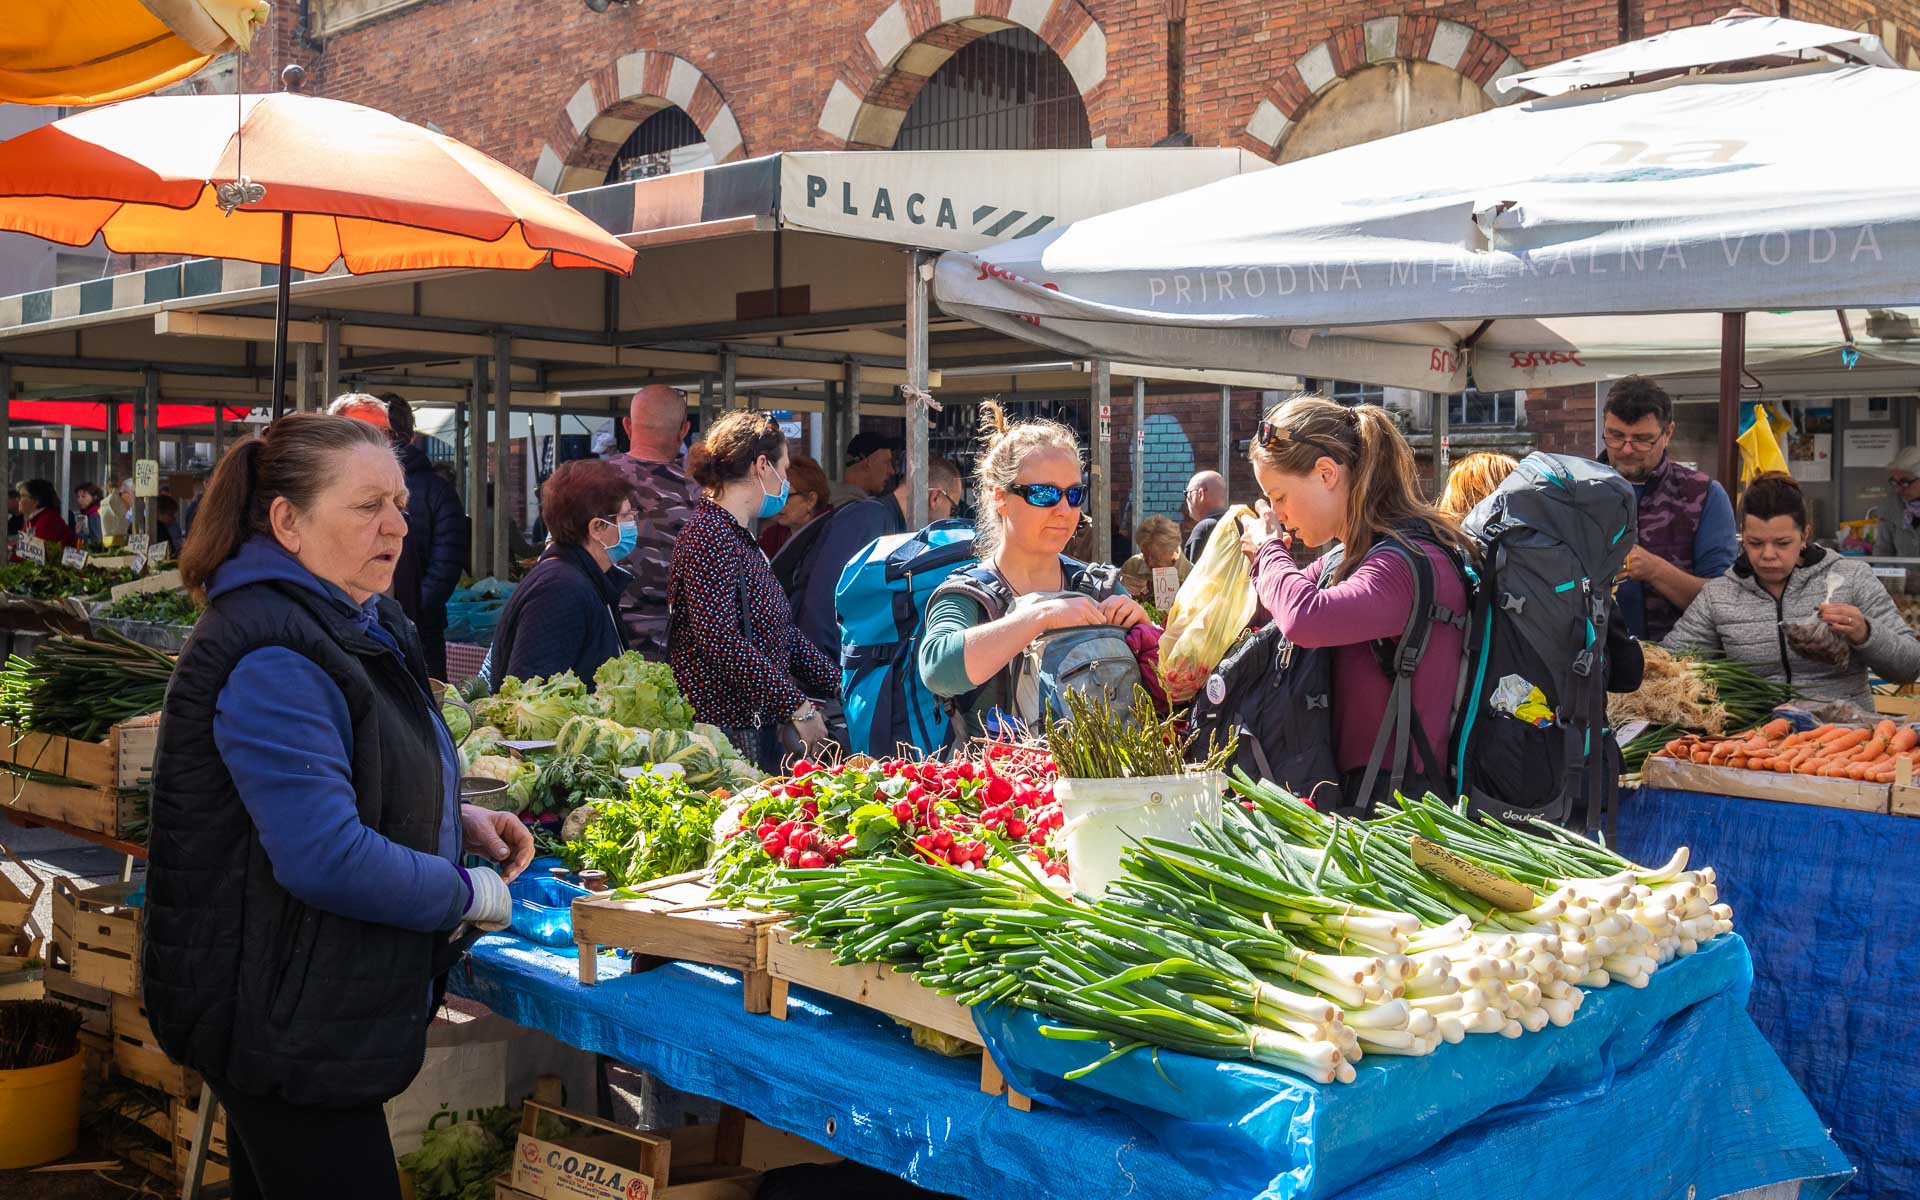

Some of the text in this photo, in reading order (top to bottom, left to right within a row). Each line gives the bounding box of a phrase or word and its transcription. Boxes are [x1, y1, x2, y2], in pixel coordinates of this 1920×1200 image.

[807, 174, 957, 230] PLACA
[1149, 259, 1362, 305] PRIRODNA
[1719, 223, 1884, 268] VODA
